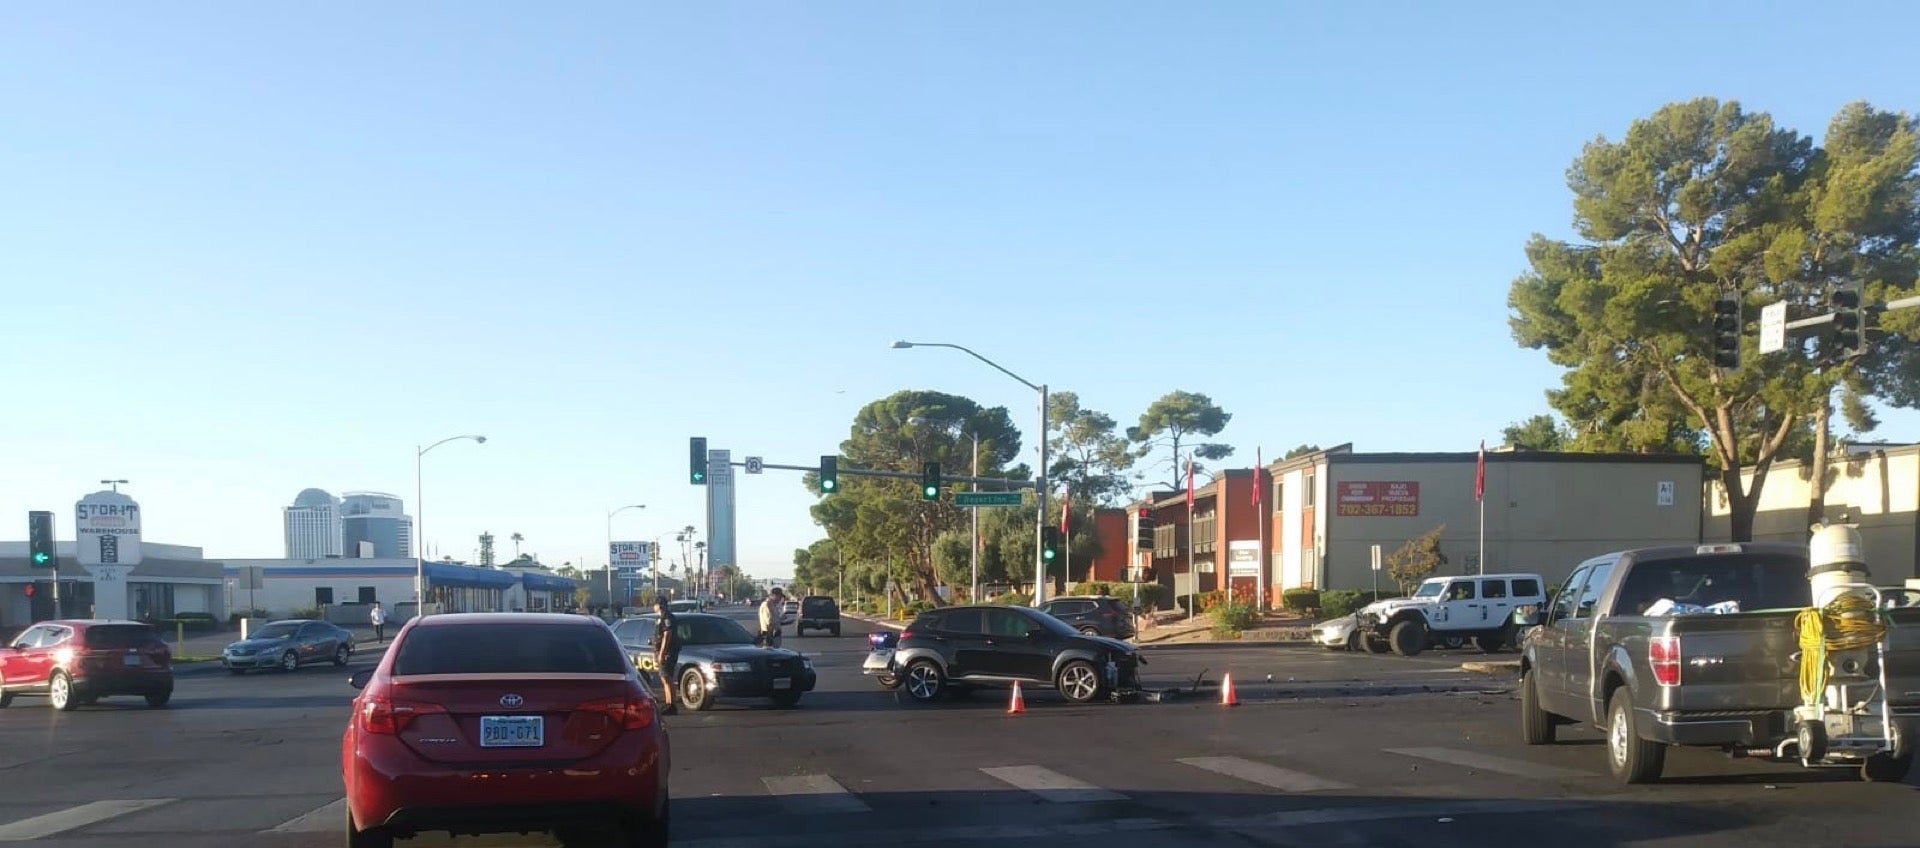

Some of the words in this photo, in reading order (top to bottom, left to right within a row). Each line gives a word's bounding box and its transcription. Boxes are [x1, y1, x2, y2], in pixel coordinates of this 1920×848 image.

[78, 504, 138, 520] STOR-IT
[79, 527, 140, 535] WAREHOUSE
[611, 544, 648, 554] STOR-IT
